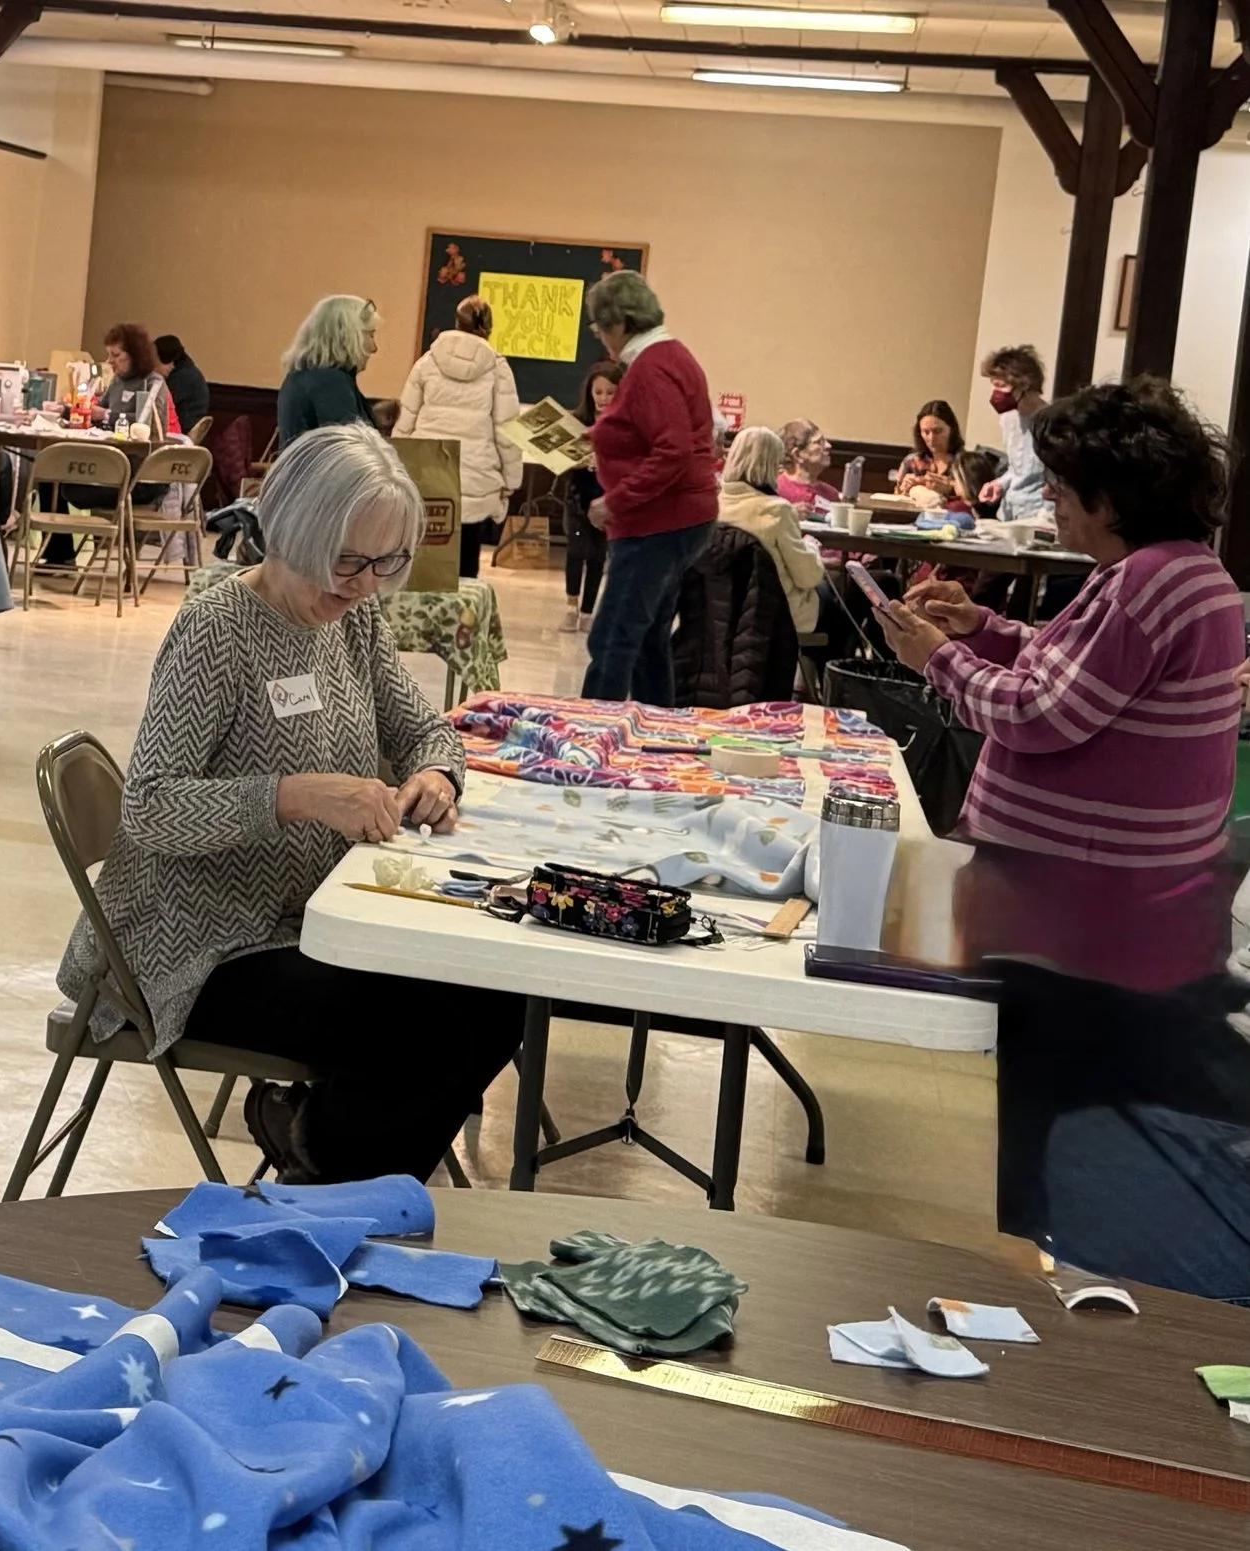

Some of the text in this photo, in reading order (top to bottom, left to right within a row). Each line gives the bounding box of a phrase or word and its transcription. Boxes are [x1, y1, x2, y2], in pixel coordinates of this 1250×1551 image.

[483, 281, 575, 317] THANK
[505, 309, 554, 335] YOU
[68, 461, 97, 475] FCC
[170, 463, 191, 475] FCC
